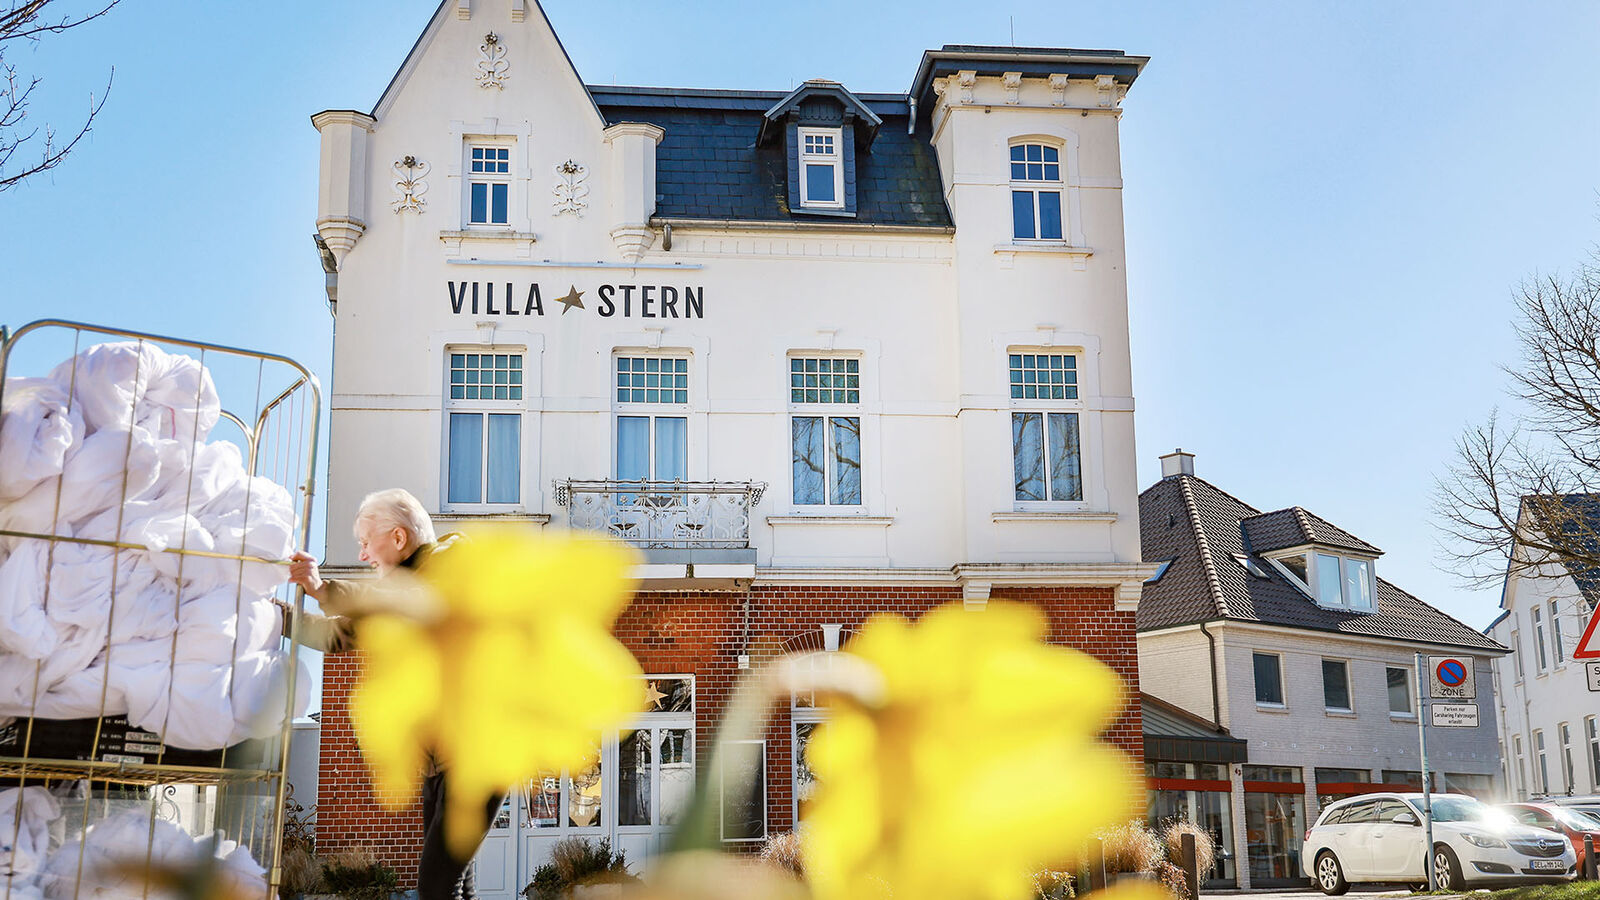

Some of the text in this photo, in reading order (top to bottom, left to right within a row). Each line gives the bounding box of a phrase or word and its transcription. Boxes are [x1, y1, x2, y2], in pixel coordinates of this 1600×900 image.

[448, 281, 704, 319] VILLA STERN
[1441, 688, 1465, 696] ZONE
